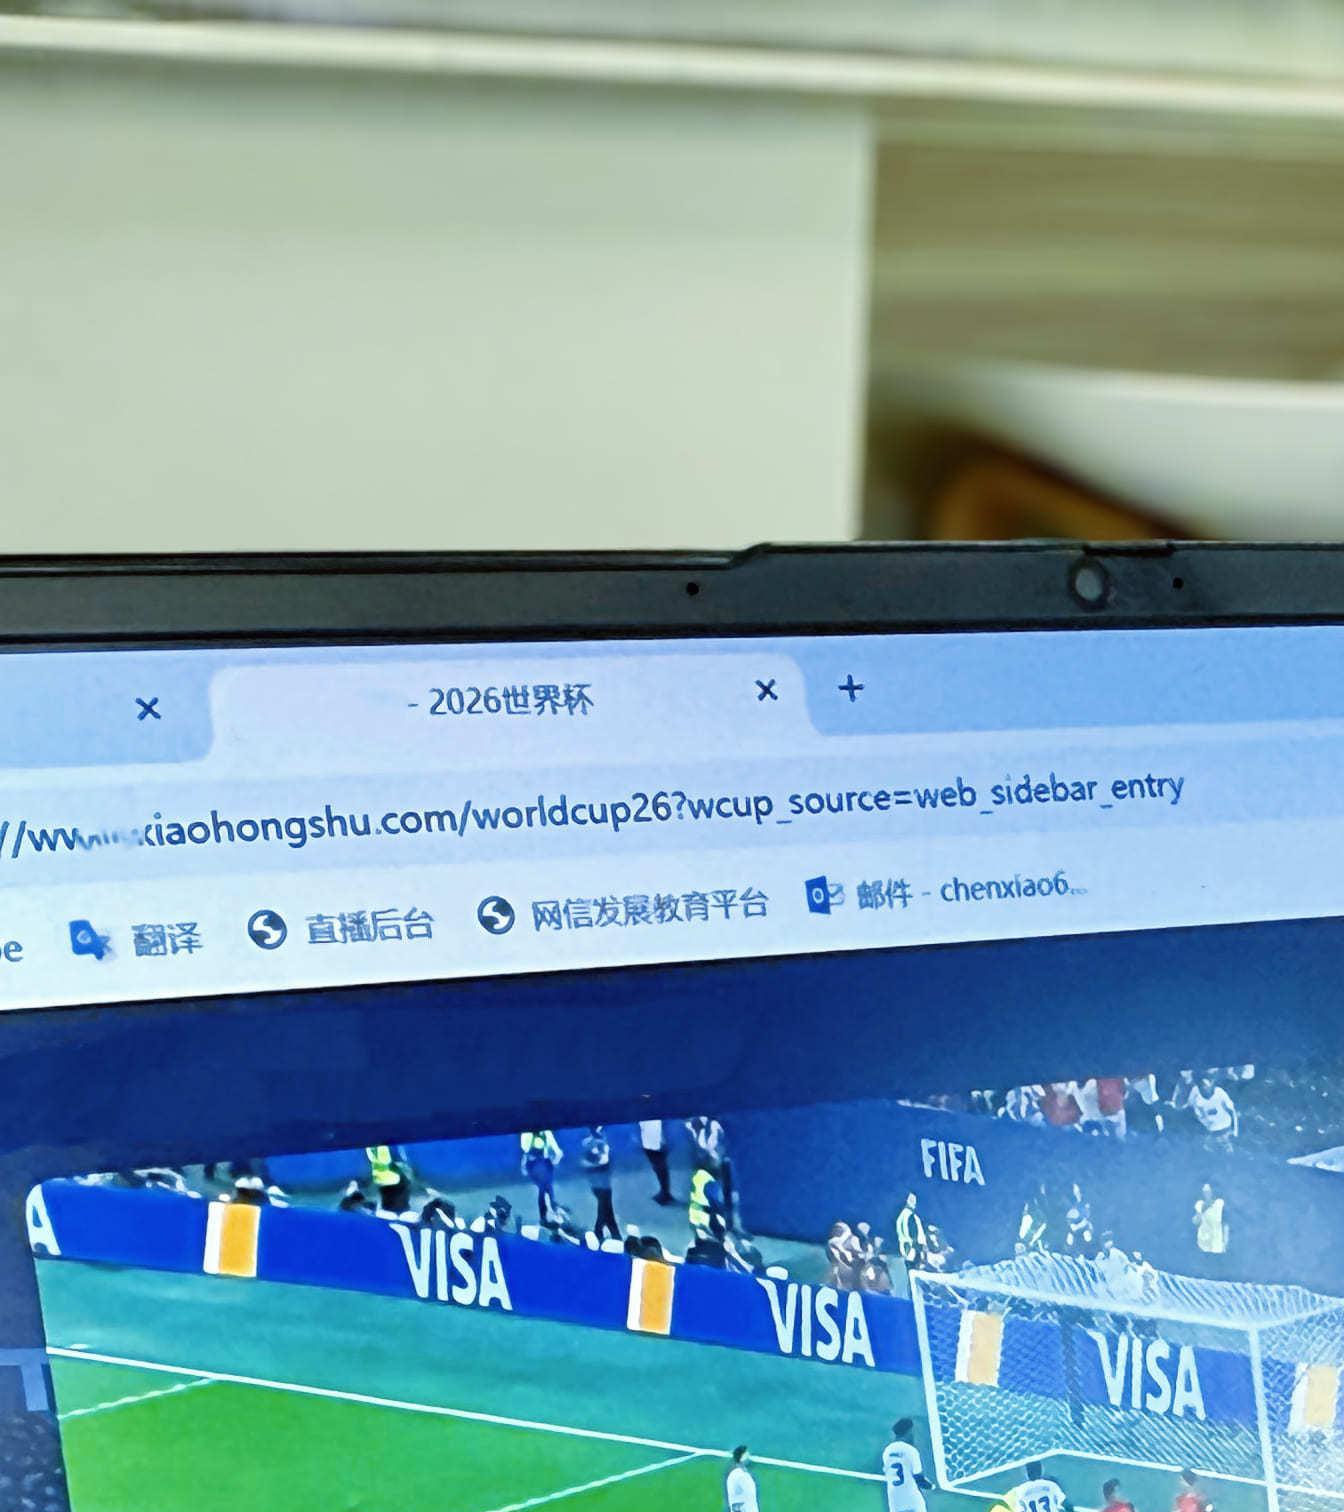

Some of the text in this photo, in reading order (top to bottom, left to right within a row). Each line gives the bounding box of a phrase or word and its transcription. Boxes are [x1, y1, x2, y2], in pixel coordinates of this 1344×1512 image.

[429, 683, 594, 717] 2026世界杯
[306, 907, 434, 945] 直播后台
[531, 888, 768, 932] 网信发展教育平台
[131, 921, 203, 958] 翻译
[920, 1138, 986, 1185] FIFA
[390, 1222, 512, 1310] VISA
[757, 1276, 876, 1368] VISA
[1094, 1330, 1207, 1419] VISA
